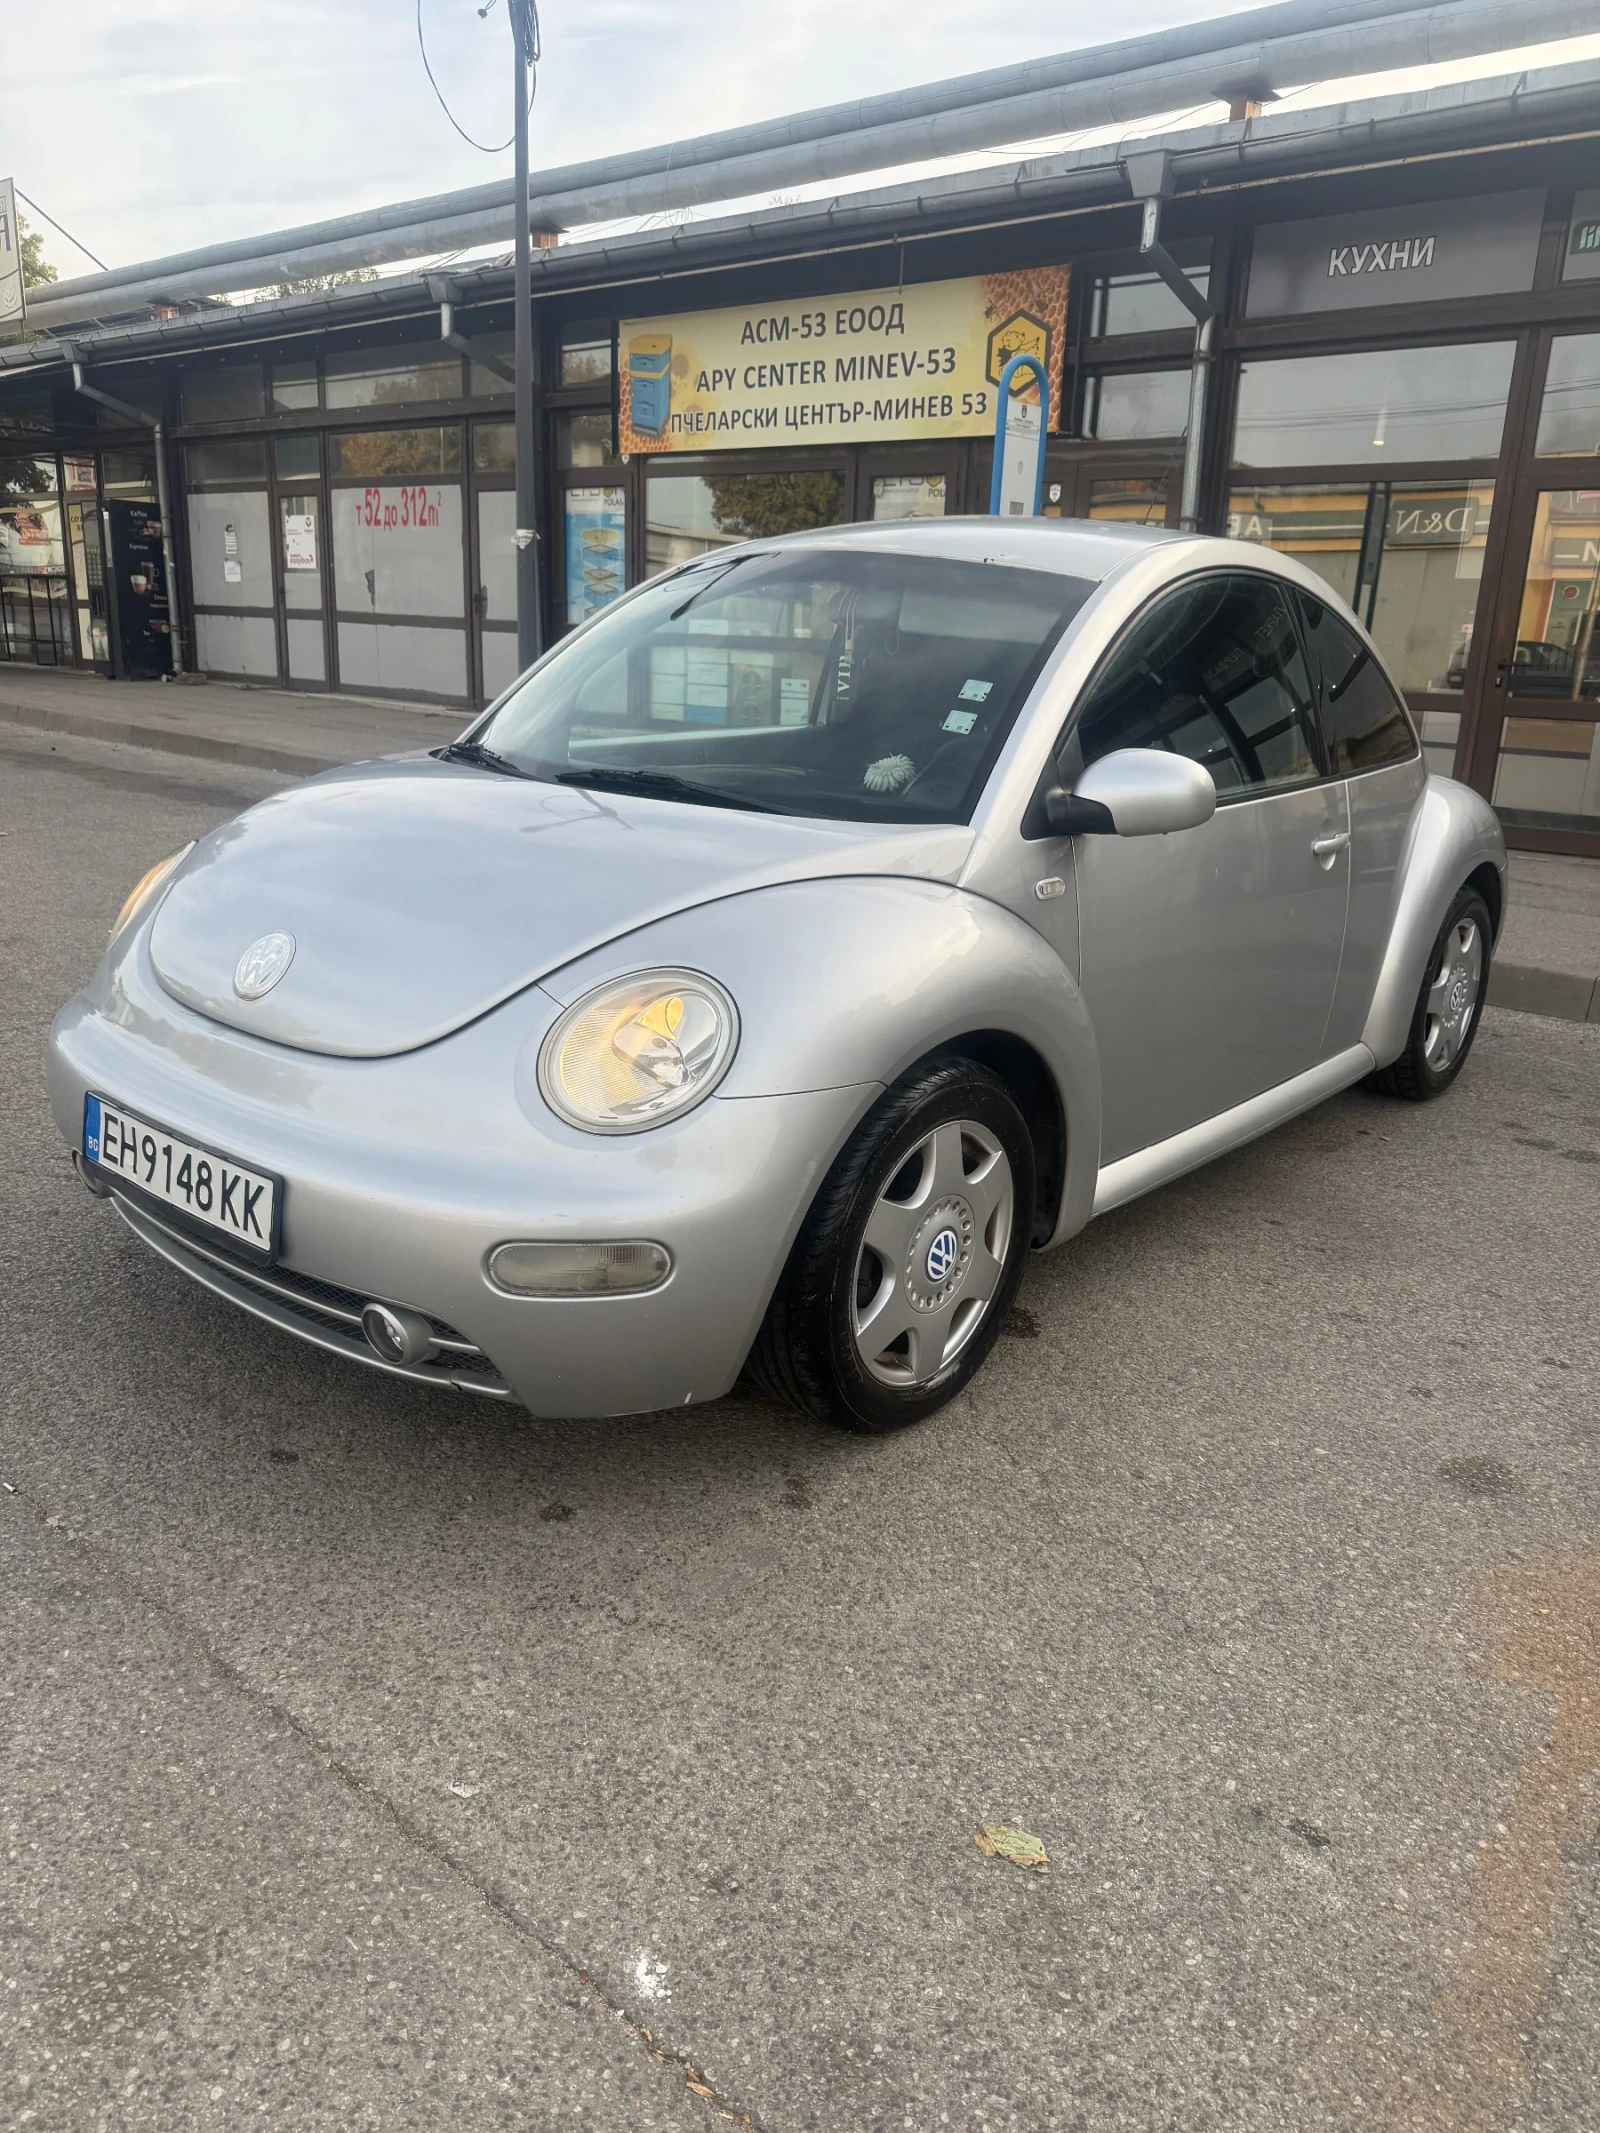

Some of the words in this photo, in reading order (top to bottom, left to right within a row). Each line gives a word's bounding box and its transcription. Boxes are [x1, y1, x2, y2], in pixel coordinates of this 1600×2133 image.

[1328, 236, 1436, 277] КУХНИ
[741, 312, 827, 345] АСМ-53
[835, 303, 905, 336] ЕООД
[696, 367, 737, 392] APY
[743, 360, 827, 389] CENTER
[835, 347, 956, 382] MINEV-53
[671, 407, 778, 433] ПЧЕЛАРСКИ
[784, 395, 953, 431] ЦЕНТЪР-МИНЕВ
[960, 392, 987, 416] 53
[365, 488, 382, 527] 52
[88, 1135, 99, 1152] BG
[103, 1112, 265, 1240] EH9148KK
